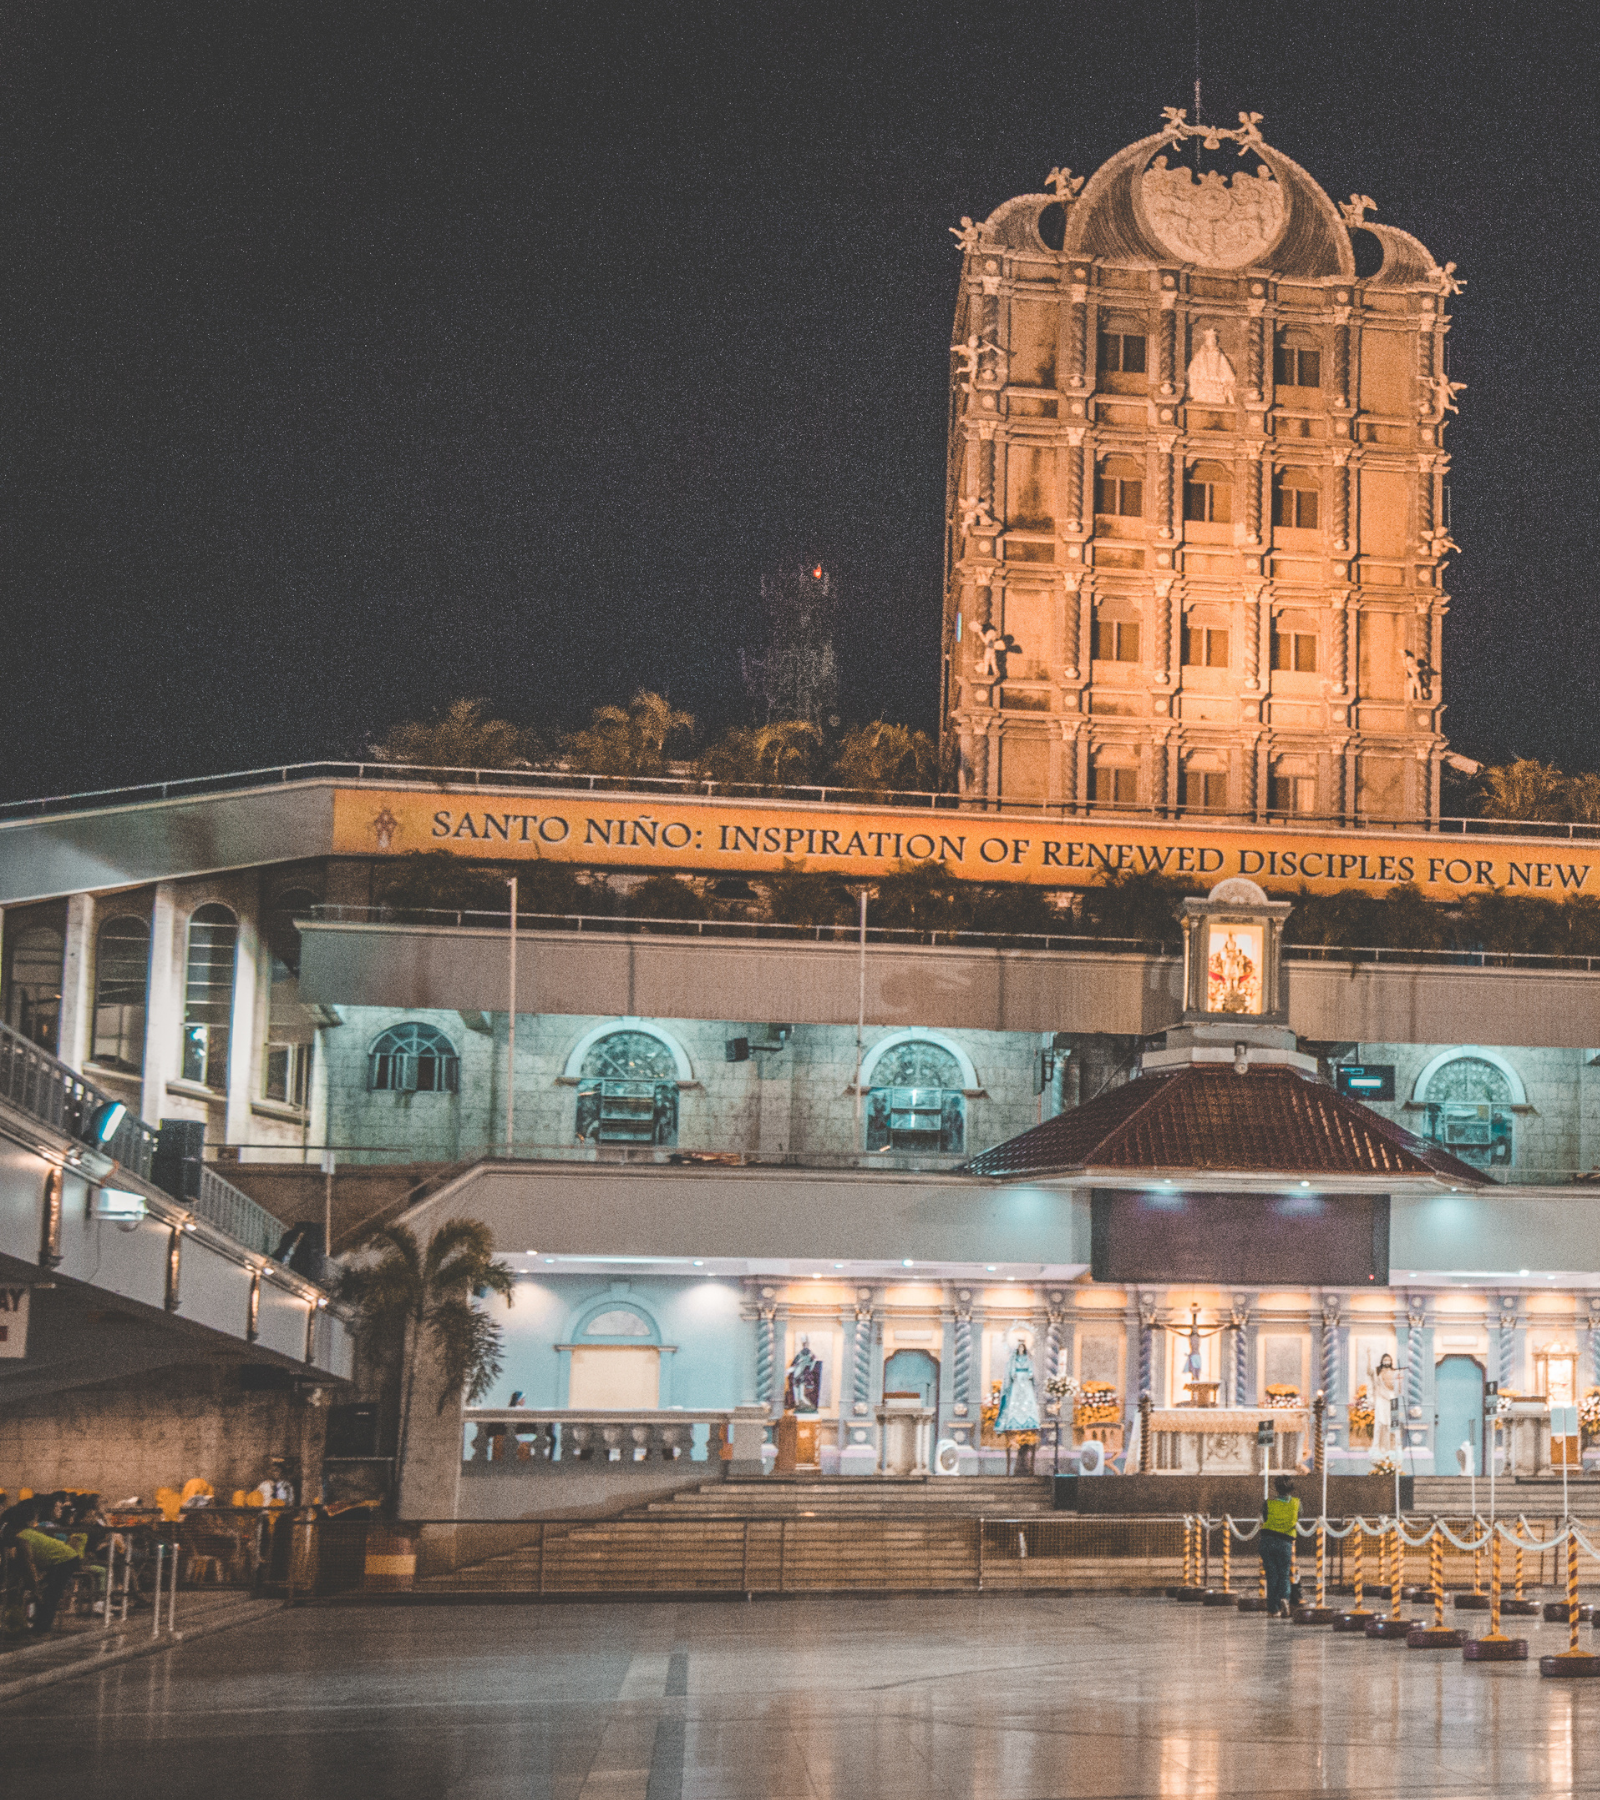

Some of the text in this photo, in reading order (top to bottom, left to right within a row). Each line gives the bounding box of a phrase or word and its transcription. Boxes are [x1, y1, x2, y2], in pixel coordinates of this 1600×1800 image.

[432, 810, 569, 845] SANTO
[584, 814, 703, 850] NIÑO:
[718, 823, 968, 863] INSPIRATION
[979, 837, 1030, 865] OF
[1042, 840, 1225, 873] RENEWED
[1238, 849, 1416, 882] DISCIPLES
[1428, 857, 1497, 886] FOR
[1507, 862, 1591, 890] NEW
